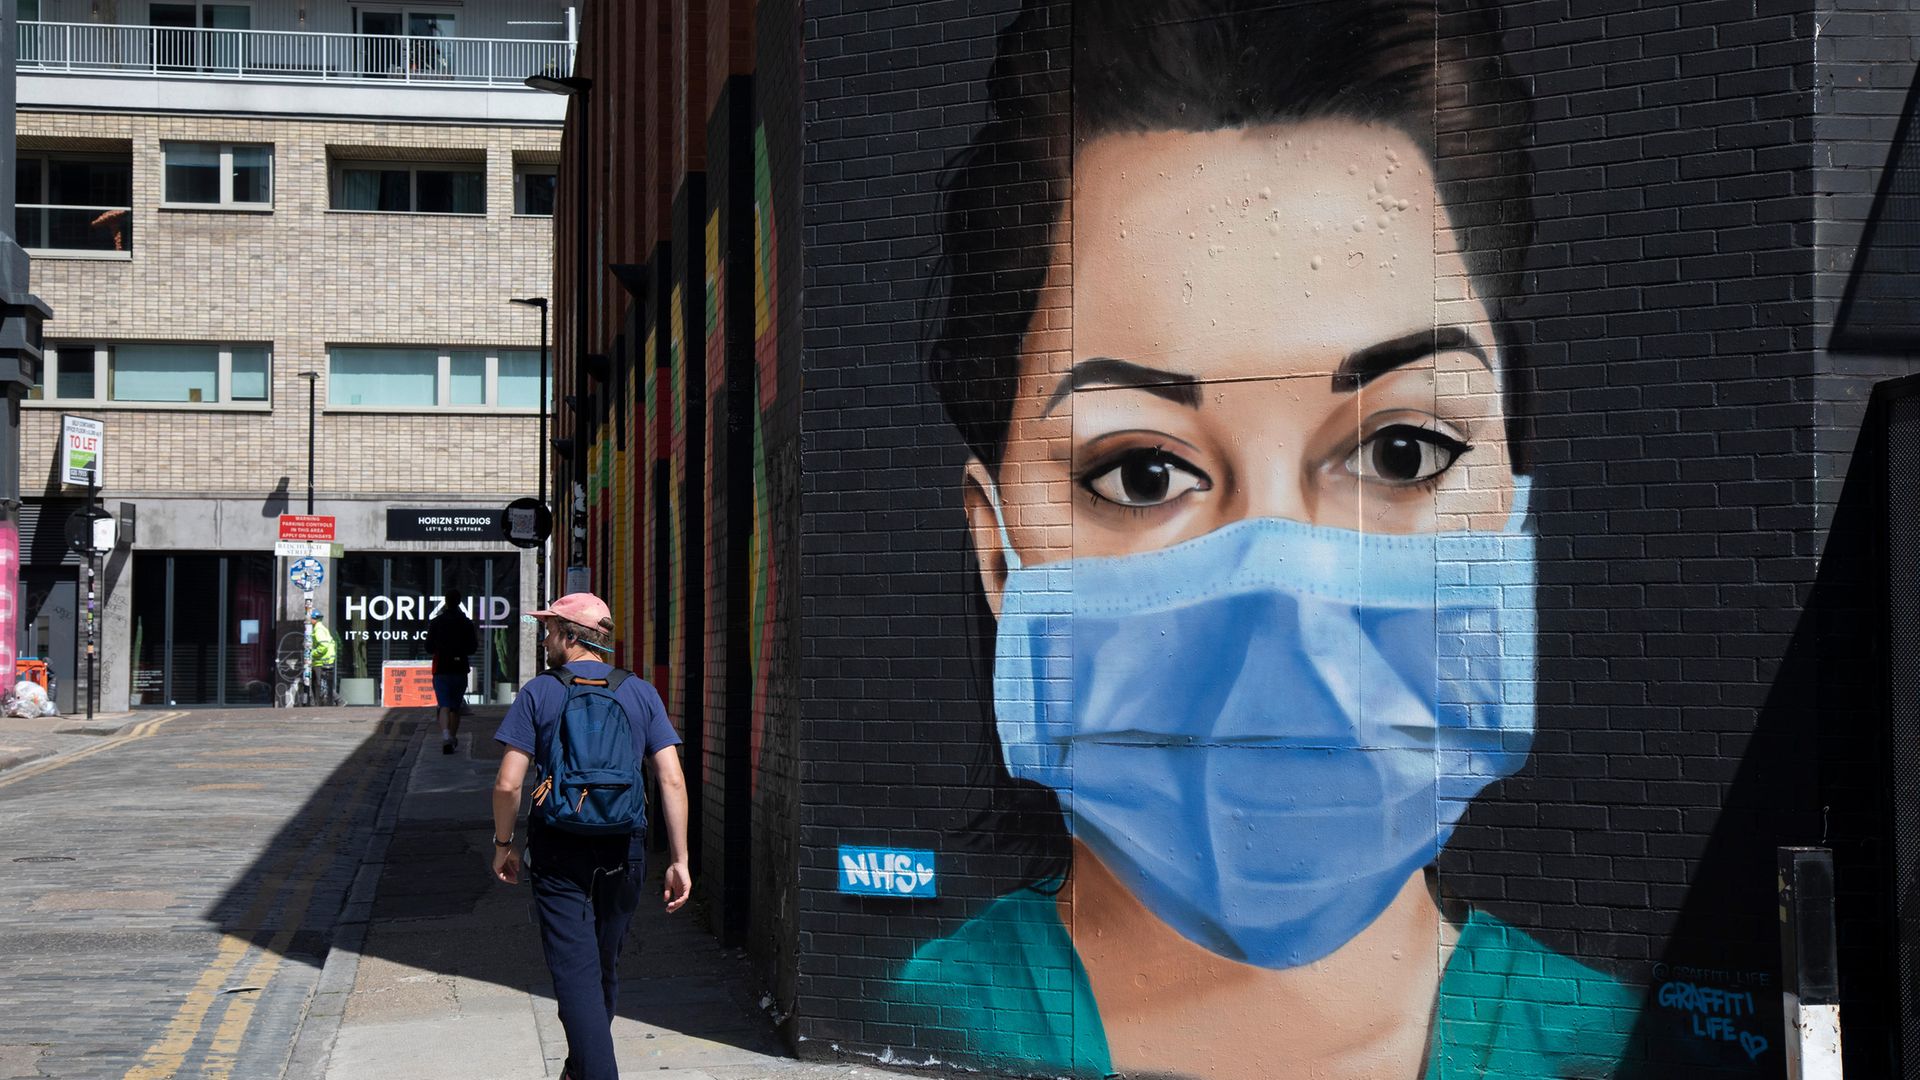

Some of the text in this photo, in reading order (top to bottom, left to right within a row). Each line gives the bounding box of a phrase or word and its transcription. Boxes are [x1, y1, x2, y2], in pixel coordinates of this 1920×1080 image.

[70, 435, 97, 451] TO LET
[418, 517, 491, 525] HORIZN STUDIOS
[345, 631, 370, 641] IT'S
[374, 631, 408, 641] YOUR
[841, 852, 917, 893] NHS
[1659, 982, 1755, 1016] GRAFFITI
[1692, 1013, 1738, 1041] LIFE
